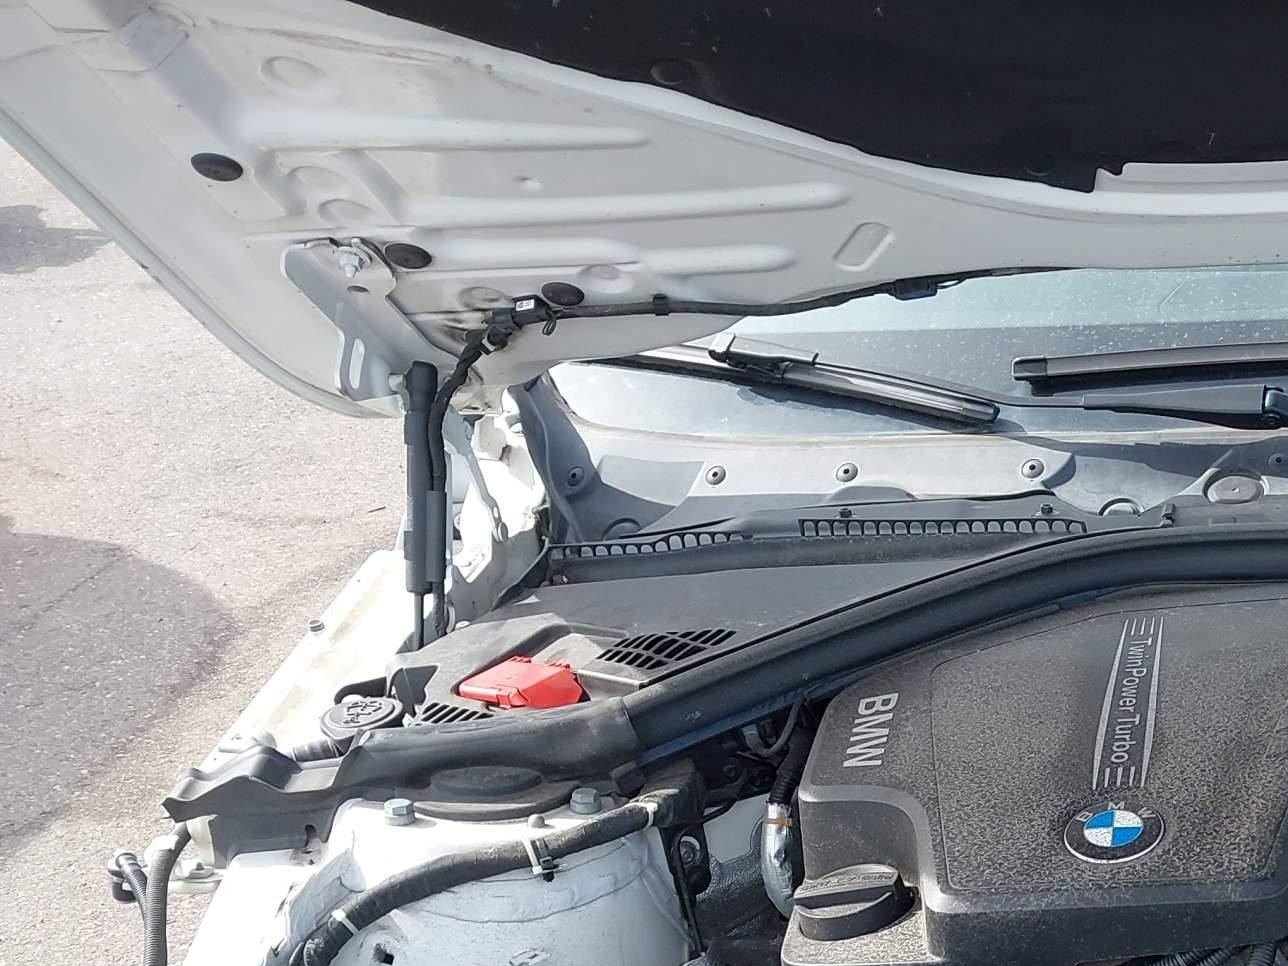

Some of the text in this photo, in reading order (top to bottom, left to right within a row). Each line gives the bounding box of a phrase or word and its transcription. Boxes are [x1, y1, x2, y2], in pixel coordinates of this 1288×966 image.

[843, 692, 899, 768] BMW
[1110, 637, 1152, 763] TwinPower Turbo
[1075, 801, 1157, 823] BMW
